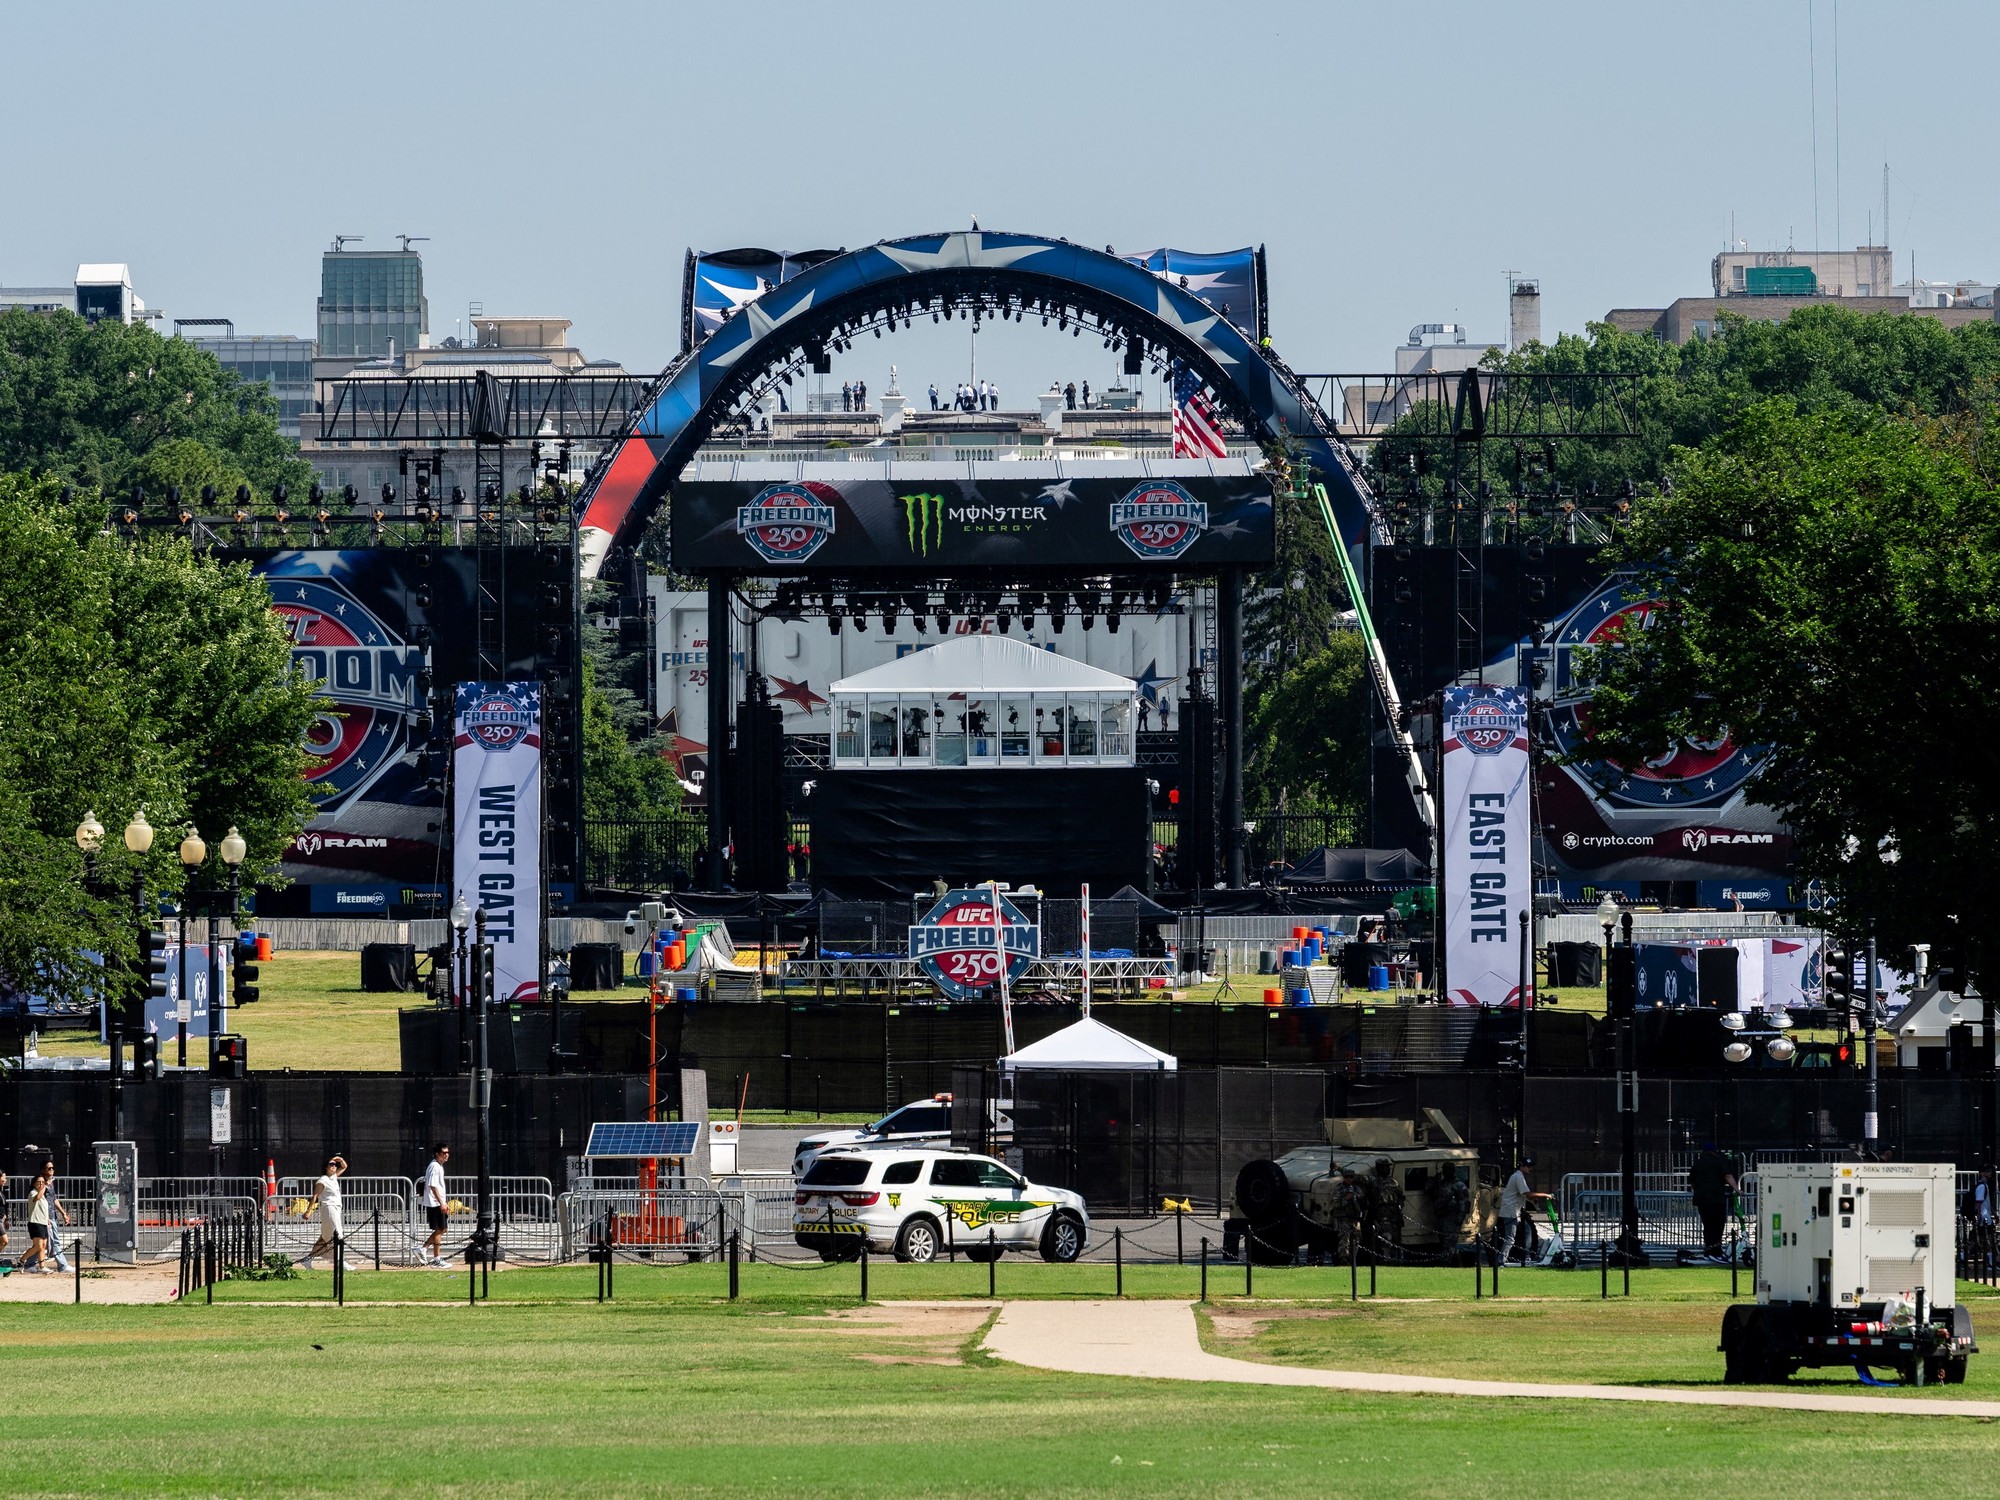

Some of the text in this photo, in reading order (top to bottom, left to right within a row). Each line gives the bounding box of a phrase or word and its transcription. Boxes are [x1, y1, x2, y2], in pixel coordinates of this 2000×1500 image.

[773, 496, 798, 505] UFC
[1146, 492, 1171, 502] UFC
[739, 507, 833, 528] FREEDOM
[949, 505, 1047, 522] MONSTER
[1111, 503, 1206, 525] FREEDOM
[768, 527, 806, 547] 250
[1141, 523, 1179, 544] 250
[463, 711, 532, 727] FREEDOM
[1451, 716, 1520, 731] FREEDOM
[484, 726, 512, 741] 250
[1473, 730, 1501, 745] 250
[325, 838, 387, 847] RAM
[1583, 836, 1654, 847] crypto.com
[1711, 835, 1773, 843] RAM
[479, 785, 515, 943] WEST GATE
[1470, 793, 1507, 943] EAST GATE
[956, 908, 993, 922] UFC
[911, 926, 1038, 957] FREEDOM
[950, 953, 1002, 981] 250
[101, 1163, 117, 1171] WAR
[889, 1198, 900, 1206] 911
